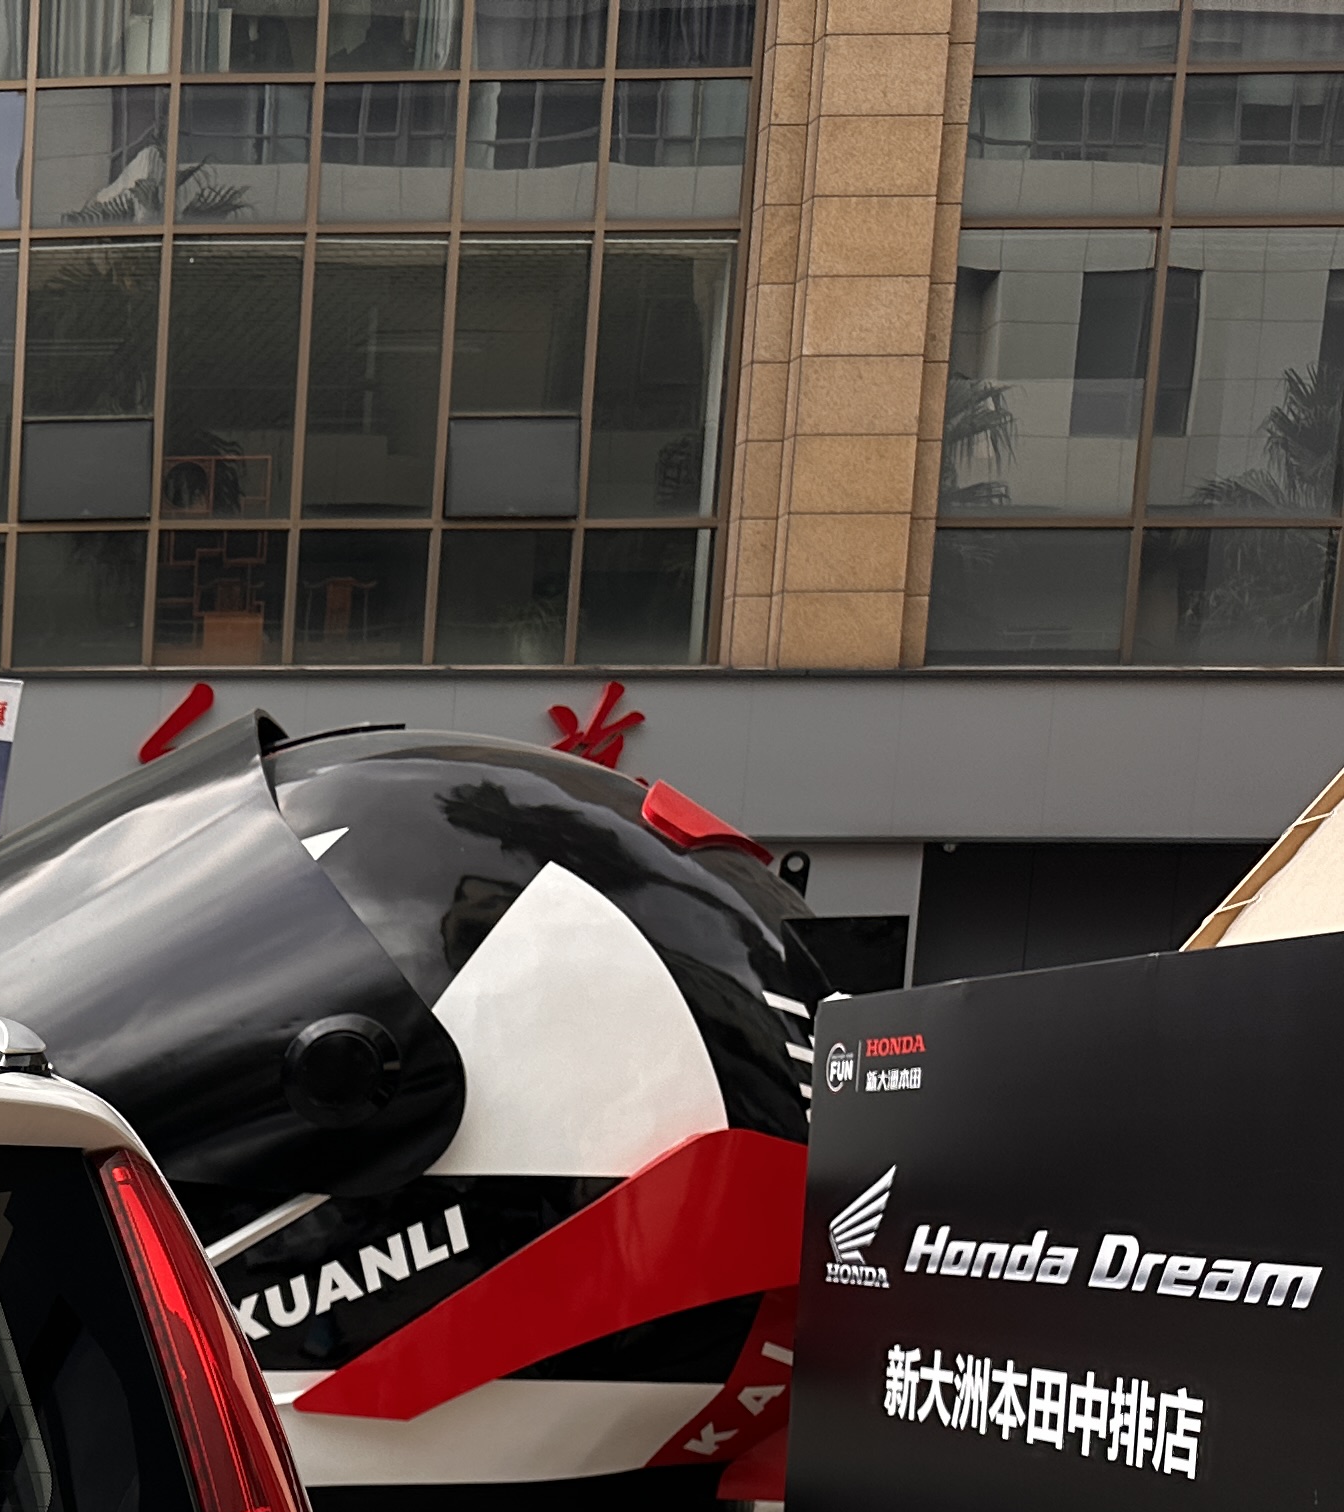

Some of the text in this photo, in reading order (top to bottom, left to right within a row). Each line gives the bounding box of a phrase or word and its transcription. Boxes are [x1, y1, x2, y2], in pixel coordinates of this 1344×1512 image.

[865, 1034, 926, 1057] HONDA
[830, 1060, 854, 1082] FUN
[865, 1067, 922, 1092] 新大洲本田
[231, 1203, 470, 1340] XUANLI
[825, 1262, 890, 1289] HONDA
[904, 1224, 1324, 1310] Honda Dream
[883, 1344, 1205, 1481] 新大洲本田中排店
